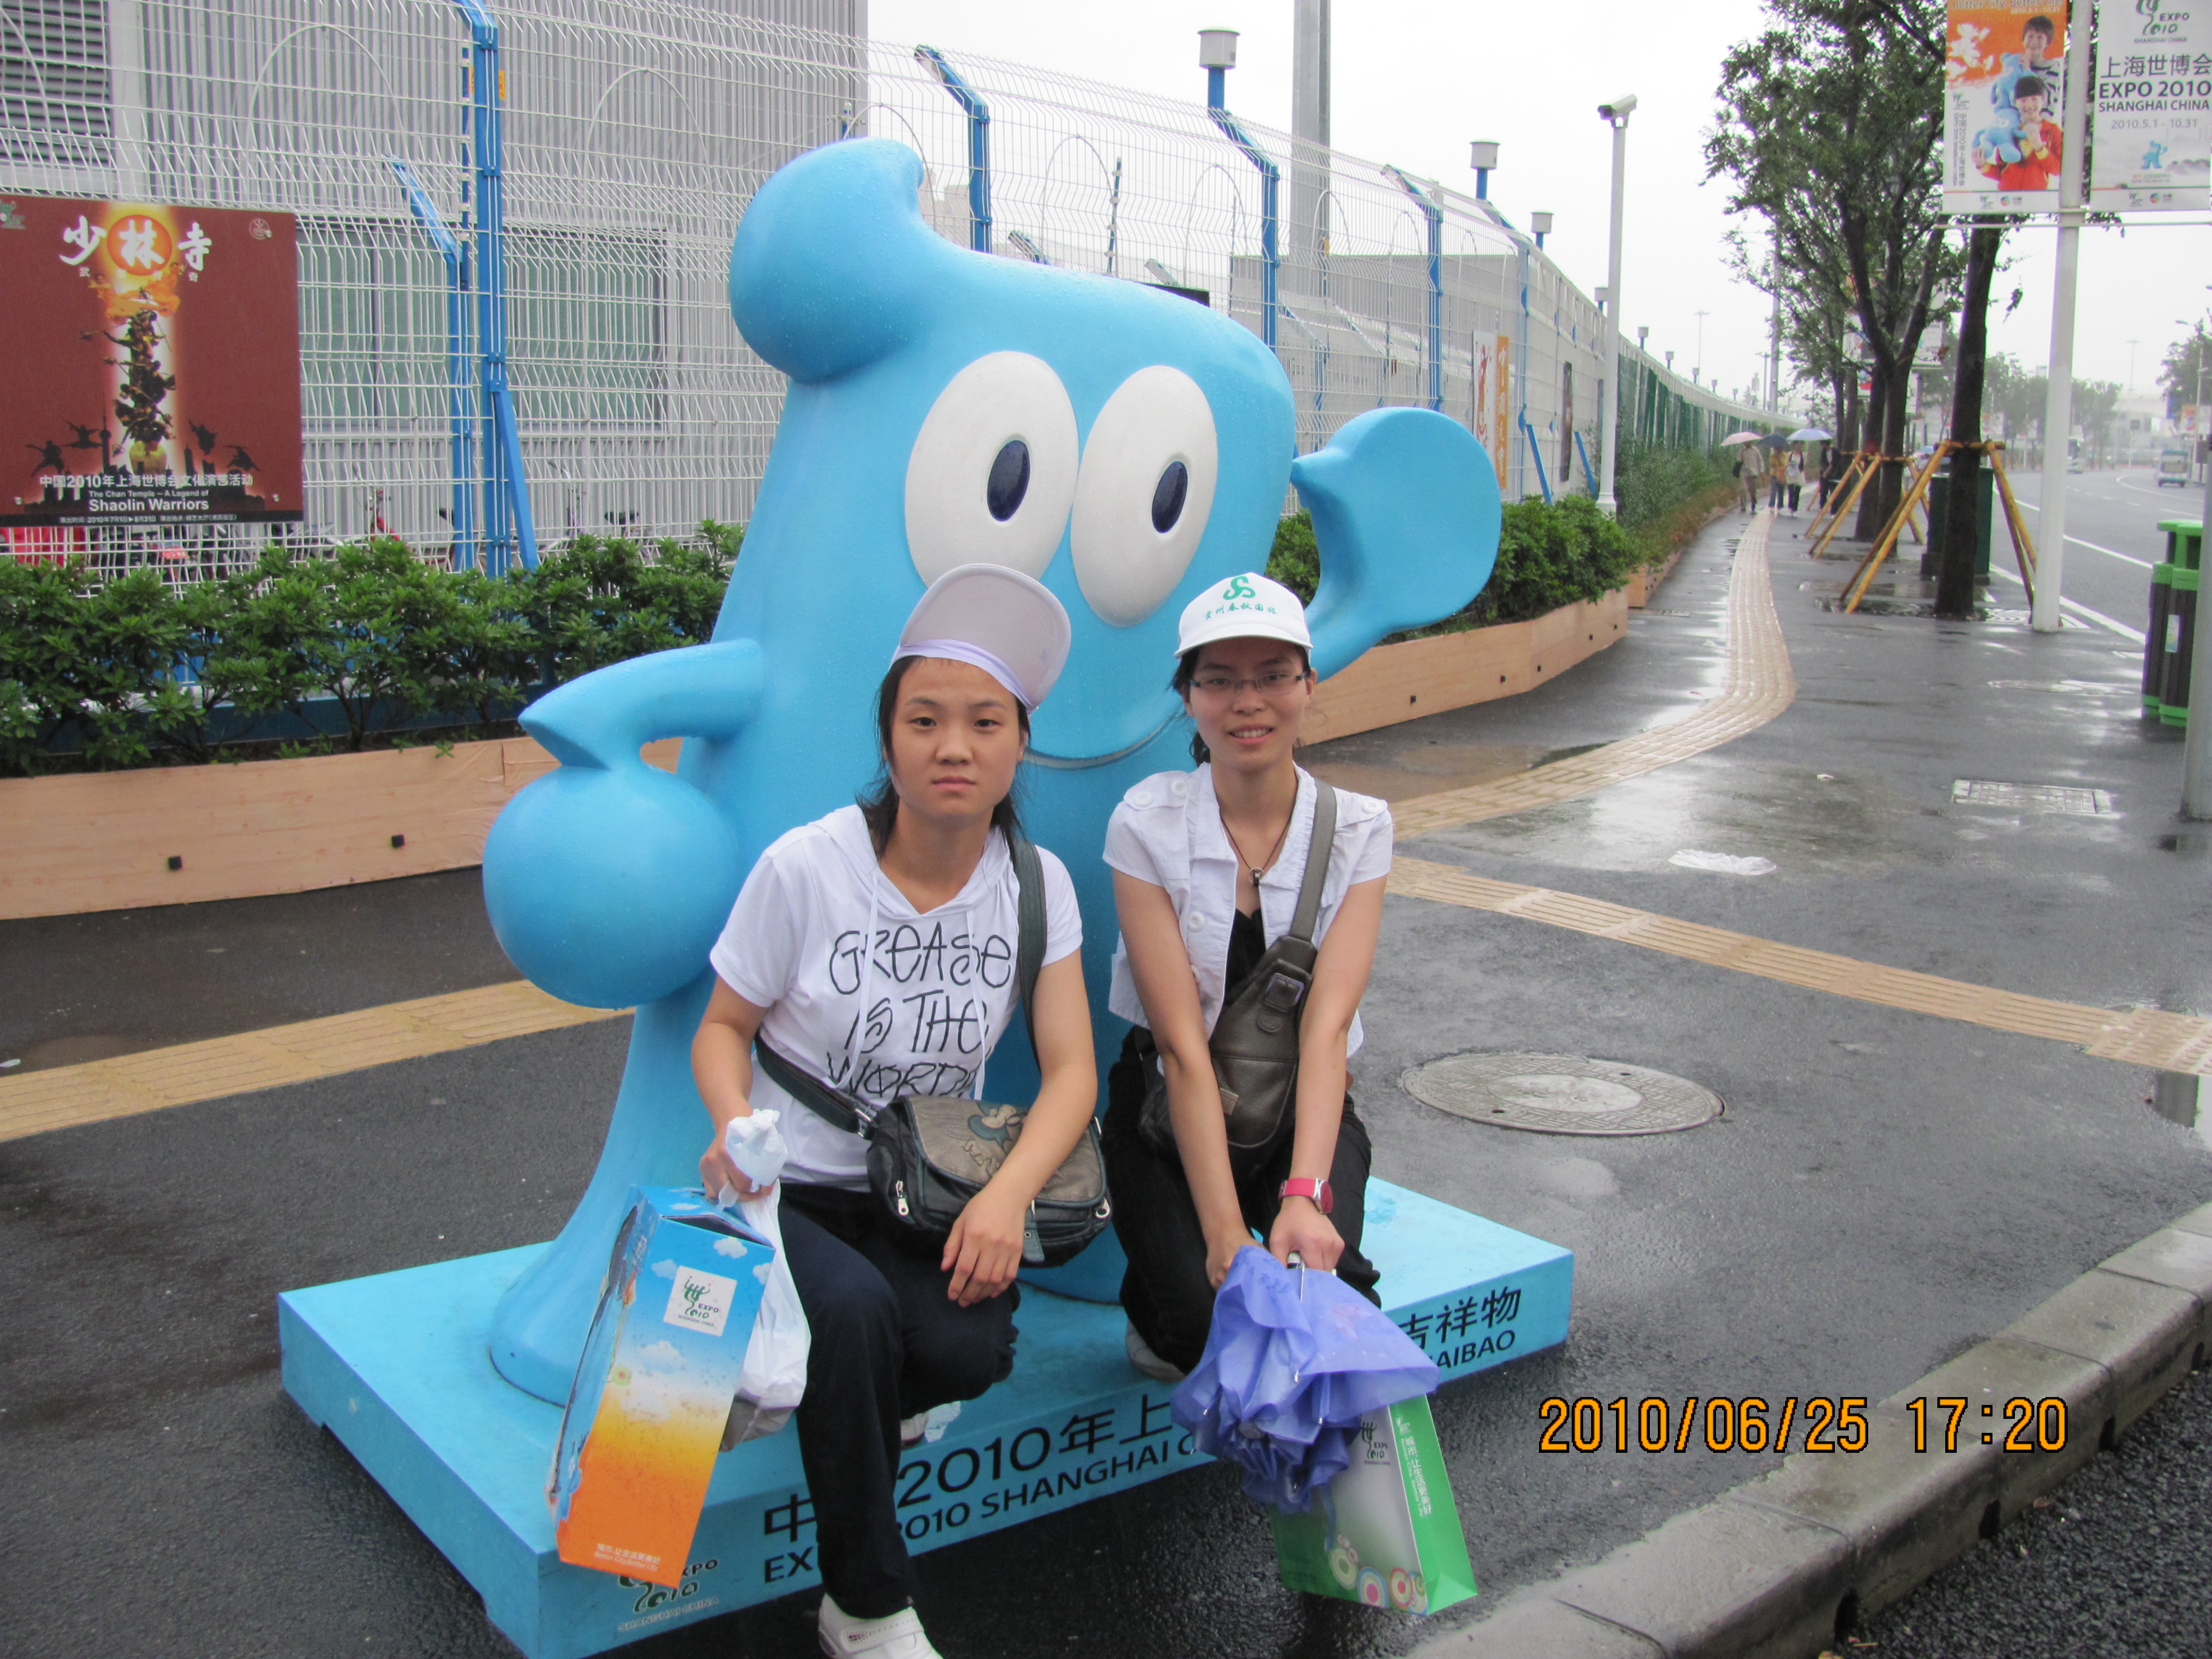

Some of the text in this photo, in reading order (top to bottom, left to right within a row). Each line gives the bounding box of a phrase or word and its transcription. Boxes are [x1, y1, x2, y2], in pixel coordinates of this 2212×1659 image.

[2160, 13, 2190, 22] EXPO
[2100, 53, 2212, 78] 上海世博会
[2099, 81, 2211, 99] EXPO 2010
[2099, 99, 2210, 113] SHANGHAI CHINA
[2111, 119, 2159, 129] 2010.5.1
[2170, 118, 2198, 128] 10.31
[59, 215, 212, 272] 少林寺
[128, 490, 155, 498] Temple
[89, 498, 209, 512] Shaolin Warriors
[698, 1303, 719, 1313] EXPO
[1429, 1329, 1516, 1369] AIBAO
[980, 1440, 1169, 1519] SHANGHAI
